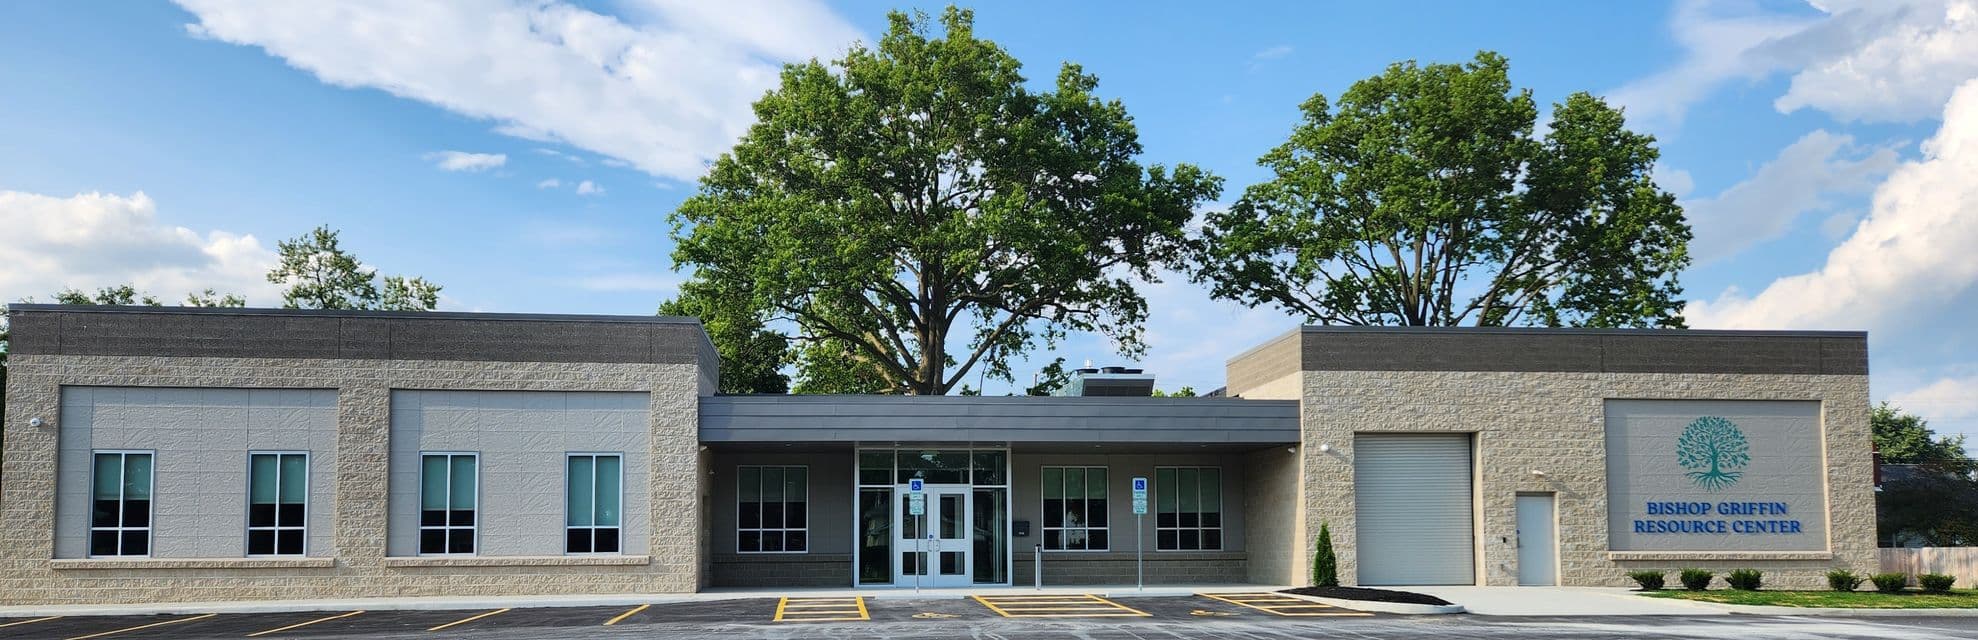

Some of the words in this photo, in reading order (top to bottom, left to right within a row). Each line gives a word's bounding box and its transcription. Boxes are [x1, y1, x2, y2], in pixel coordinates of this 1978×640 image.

[1646, 502, 1712, 515] BISHOP
[1717, 502, 1787, 515] GRIFFIN
[1634, 520, 1726, 533] RESOURCE
[1732, 520, 1801, 533] CENTER
